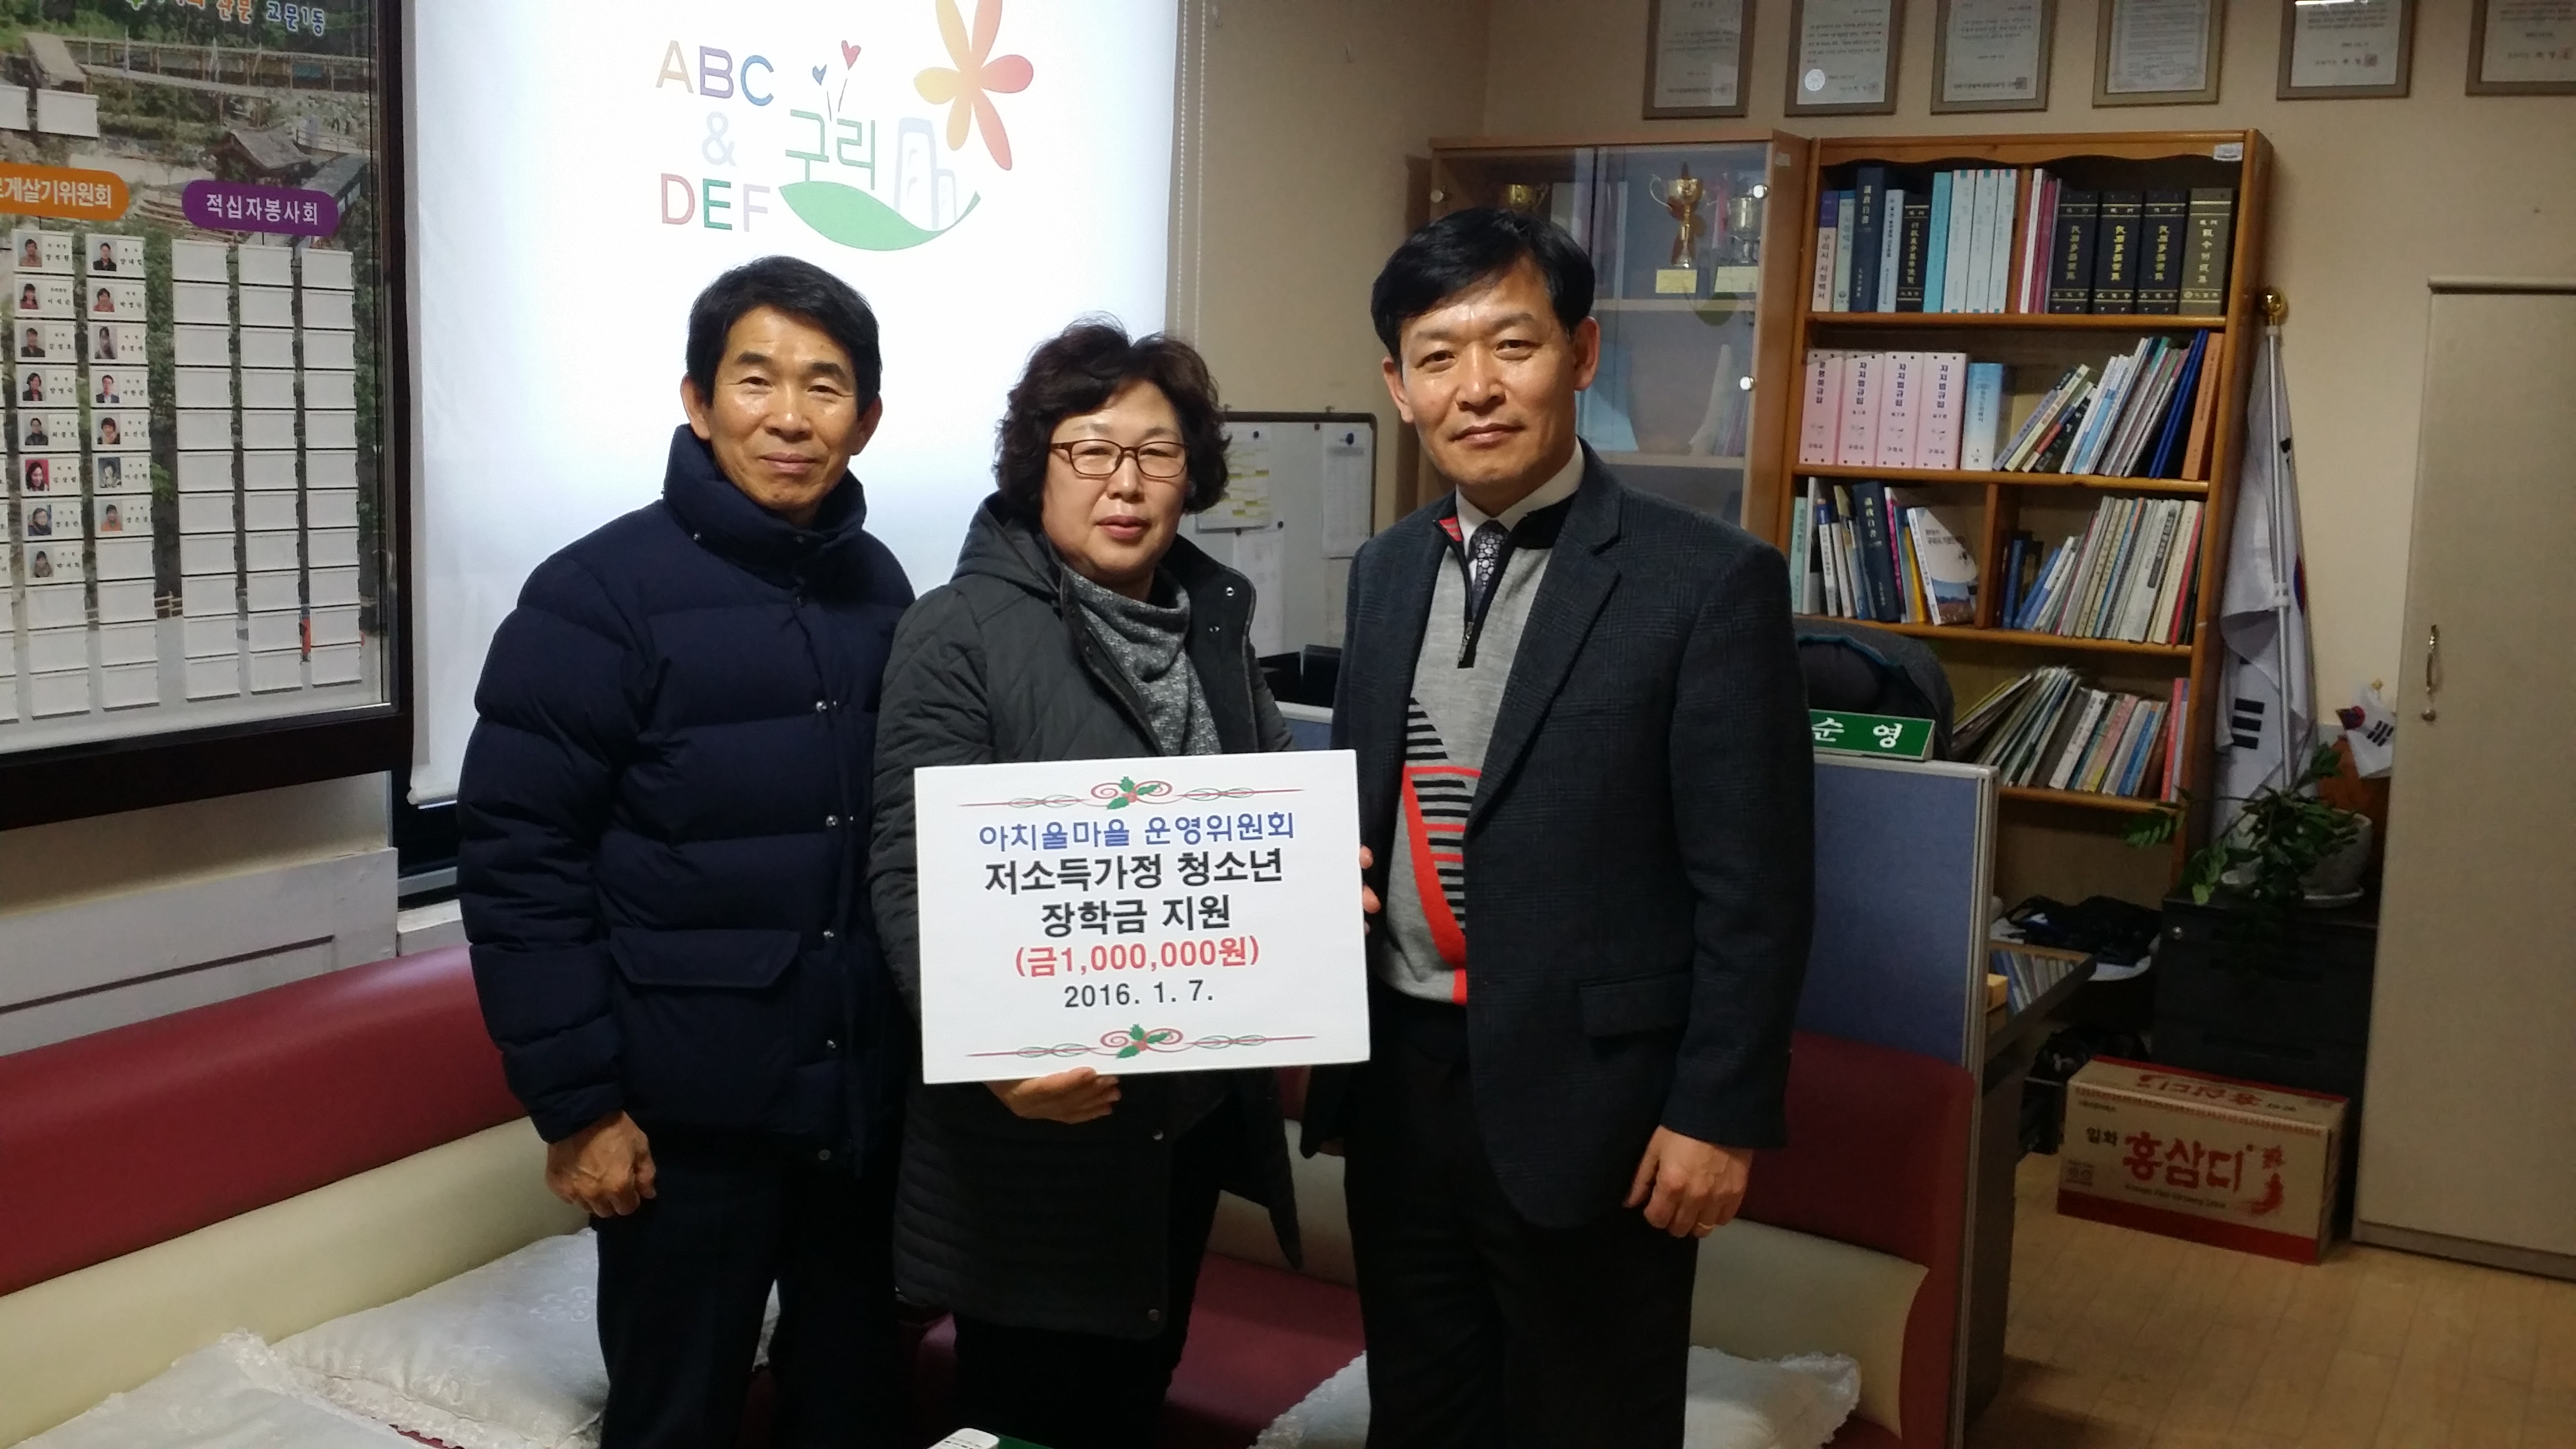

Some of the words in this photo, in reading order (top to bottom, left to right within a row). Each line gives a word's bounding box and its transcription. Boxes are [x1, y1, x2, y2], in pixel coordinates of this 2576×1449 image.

[266, 1, 324, 36] 교문1동
[655, 39, 774, 107] ABC
[701, 111, 737, 167] &
[786, 109, 876, 190] 구리
[206, 193, 319, 225] 적십자봉사회
[661, 173, 771, 232] DEF
[980, 817, 1130, 852] 아치울마을
[1144, 811, 1295, 846] 운영위원회
[985, 852, 1164, 895] 저소득가정
[1177, 847, 1283, 887] 청소년
[1041, 898, 1148, 937] 장학금
[1161, 894, 1232, 930] 지원
[1015, 935, 1260, 978] (금1,000,000원)
[1063, 982, 1141, 1008] 2016.
[1153, 980, 1177, 1003] 1.
[1188, 978, 1214, 1002] 7.
[2123, 1131, 2244, 1194] 홍삼디
